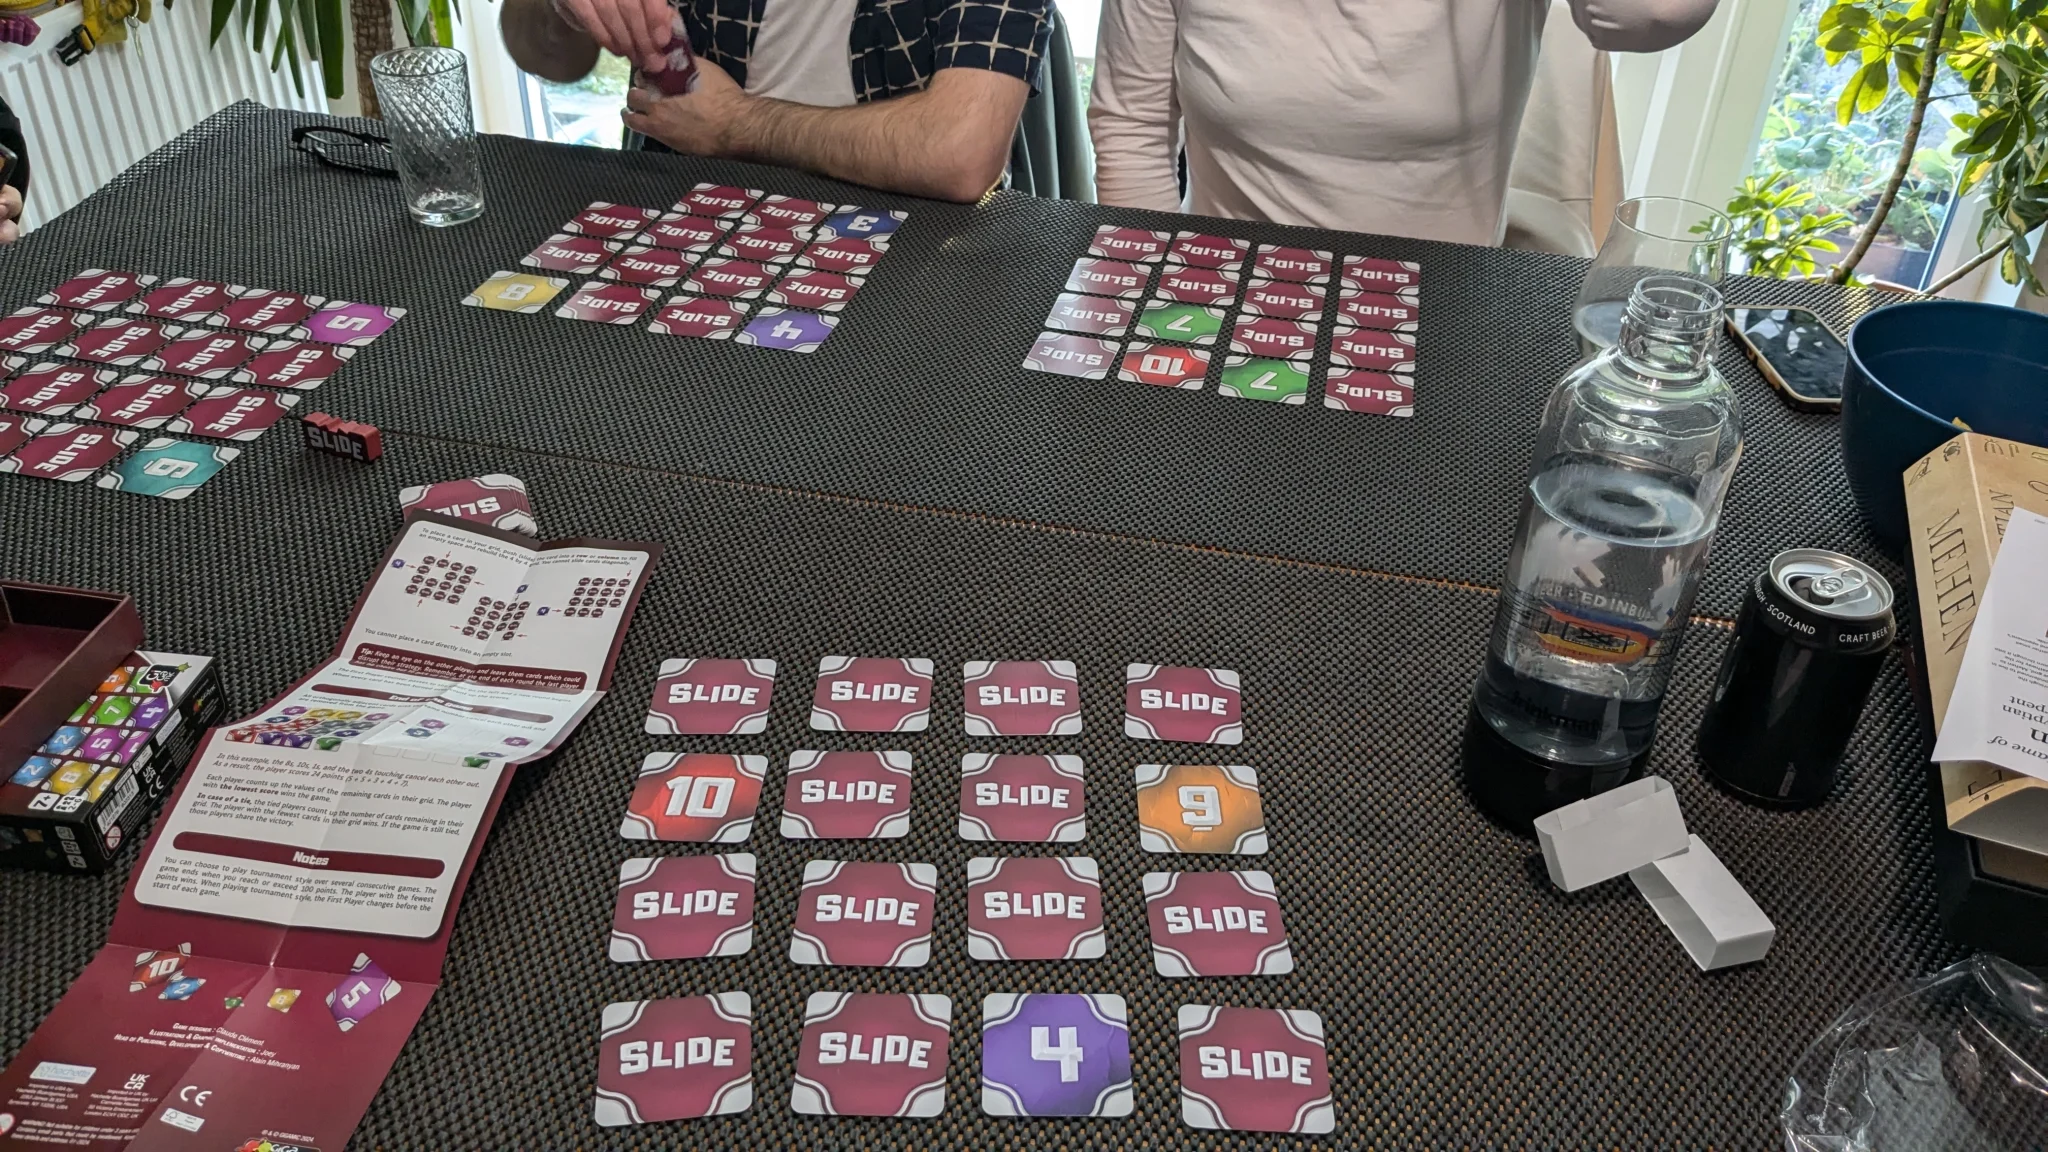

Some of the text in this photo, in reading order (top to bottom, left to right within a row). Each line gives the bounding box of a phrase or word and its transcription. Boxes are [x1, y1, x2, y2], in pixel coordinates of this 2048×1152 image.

[691, 194, 745, 208] SLIDE
[584, 213, 640, 228] SLIDE
[762, 206, 816, 221] SLIDE
[657, 225, 713, 240] SLIDE
[848, 216, 879, 231] 3
[736, 236, 793, 251] SLIDE
[1101, 237, 1156, 251] SLIDE
[1180, 243, 1236, 259] SLIDE
[542, 246, 600, 262] SLIDE
[813, 247, 871, 263] SLIDE
[621, 258, 680, 274] SLIDE
[1264, 257, 1320, 271] SLIDE
[702, 270, 762, 286] SLIDE
[1079, 271, 1137, 286] SLIDE
[1351, 268, 1409, 283] SLIDE
[70, 277, 127, 304] SLIDE
[497, 283, 535, 300] 8
[786, 281, 846, 299] SLIDE
[1168, 278, 1226, 293] SLIDE
[159, 285, 216, 313] SLIDE
[578, 295, 641, 313] SLIDE
[1254, 292, 1313, 309] SLIDE
[240, 297, 295, 326] SLIDE
[668, 310, 731, 326] SLIDE
[1060, 306, 1120, 323] SLIDE
[1347, 303, 1407, 318] SLIDE
[1, 316, 62, 346] SLIDE
[326, 316, 371, 331] 5
[771, 320, 802, 339] 4
[1167, 315, 1193, 331] 7
[89, 327, 151, 357] SLIDE
[1242, 329, 1304, 346] SLIDE
[177, 339, 235, 370] SLIDE
[1039, 346, 1102, 366] SLIDE
[1341, 341, 1404, 358] SLIDE
[268, 350, 323, 381] SLIDE
[1140, 354, 1185, 376] 10
[19, 372, 84, 406] SLIDE
[1251, 372, 1277, 390] 7
[111, 384, 176, 419] SLIDE
[1336, 383, 1402, 402] SLIDE
[205, 397, 267, 432] SLIDE
[308, 426, 364, 460] SLIDE
[34, 434, 103, 473] SLIDE
[144, 458, 198, 478] 6
[1927, 509, 1976, 655] MEHEN
[1767, 604, 1816, 634] SCOTLAND
[1839, 627, 1888, 642] CRAFT BEER
[669, 684, 759, 704] SLIDE
[831, 681, 919, 703] SLIDE
[979, 686, 1065, 705] SLIDE
[1141, 689, 1227, 715] SLIDE
[142, 707, 164, 718] 4
[91, 738, 112, 747] 5
[1987, 735, 2048, 763] ame of
[234, 785, 258, 793] lowest
[311, 794, 331, 802] game.
[666, 776, 735, 817] 10
[801, 780, 896, 803] SLIDE
[976, 783, 1069, 808] SLIDE
[1179, 786, 1221, 830] 9
[209, 810, 233, 818] players
[235, 812, 253, 820] share
[269, 816, 294, 826] victory.
[293, 851, 329, 865] Notes
[159, 865, 179, 873] game
[182, 868, 198, 876] ends
[202, 871, 220, 879] when
[240, 876, 258, 884] reach
[273, 881, 297, 891] exceed
[316, 887, 337, 895] points.
[341, 888, 353, 896] The
[355, 890, 376, 898] player
[411, 894, 434, 902] fewest
[195, 859, 219, 870] choose
[232, 866, 248, 874] play
[251, 869, 292, 881] tournament
[295, 876, 312, 884] style
[357, 881, 395, 890] consecutive
[153, 881, 170, 889] start
[182, 885, 198, 893] each
[156, 873, 178, 881] points
[181, 876, 198, 884] wins.
[201, 879, 220, 888] When
[222, 882, 248, 893] playing
[251, 887, 293, 898] tournament
[295, 893, 312, 901] style,
[344, 897, 365, 906] Player
[366, 900, 393, 908] changes
[396, 902, 417, 910] before
[634, 890, 738, 919] SLIDE
[816, 895, 919, 926] SLIDE
[984, 892, 1085, 919] SLIDE
[1164, 906, 1268, 933] SLIDE
[149, 958, 179, 977] 10
[174, 983, 190, 994] 2
[341, 981, 371, 1009] 5
[217, 1027, 237, 1039] Claude
[620, 1037, 735, 1074] SLIDE
[819, 1032, 932, 1068] SLIDE
[1032, 1027, 1083, 1082] 4
[250, 1056, 266, 1065] Alain
[1199, 1046, 1311, 1085] SLIDE
[130, 1074, 150, 1082] UK
